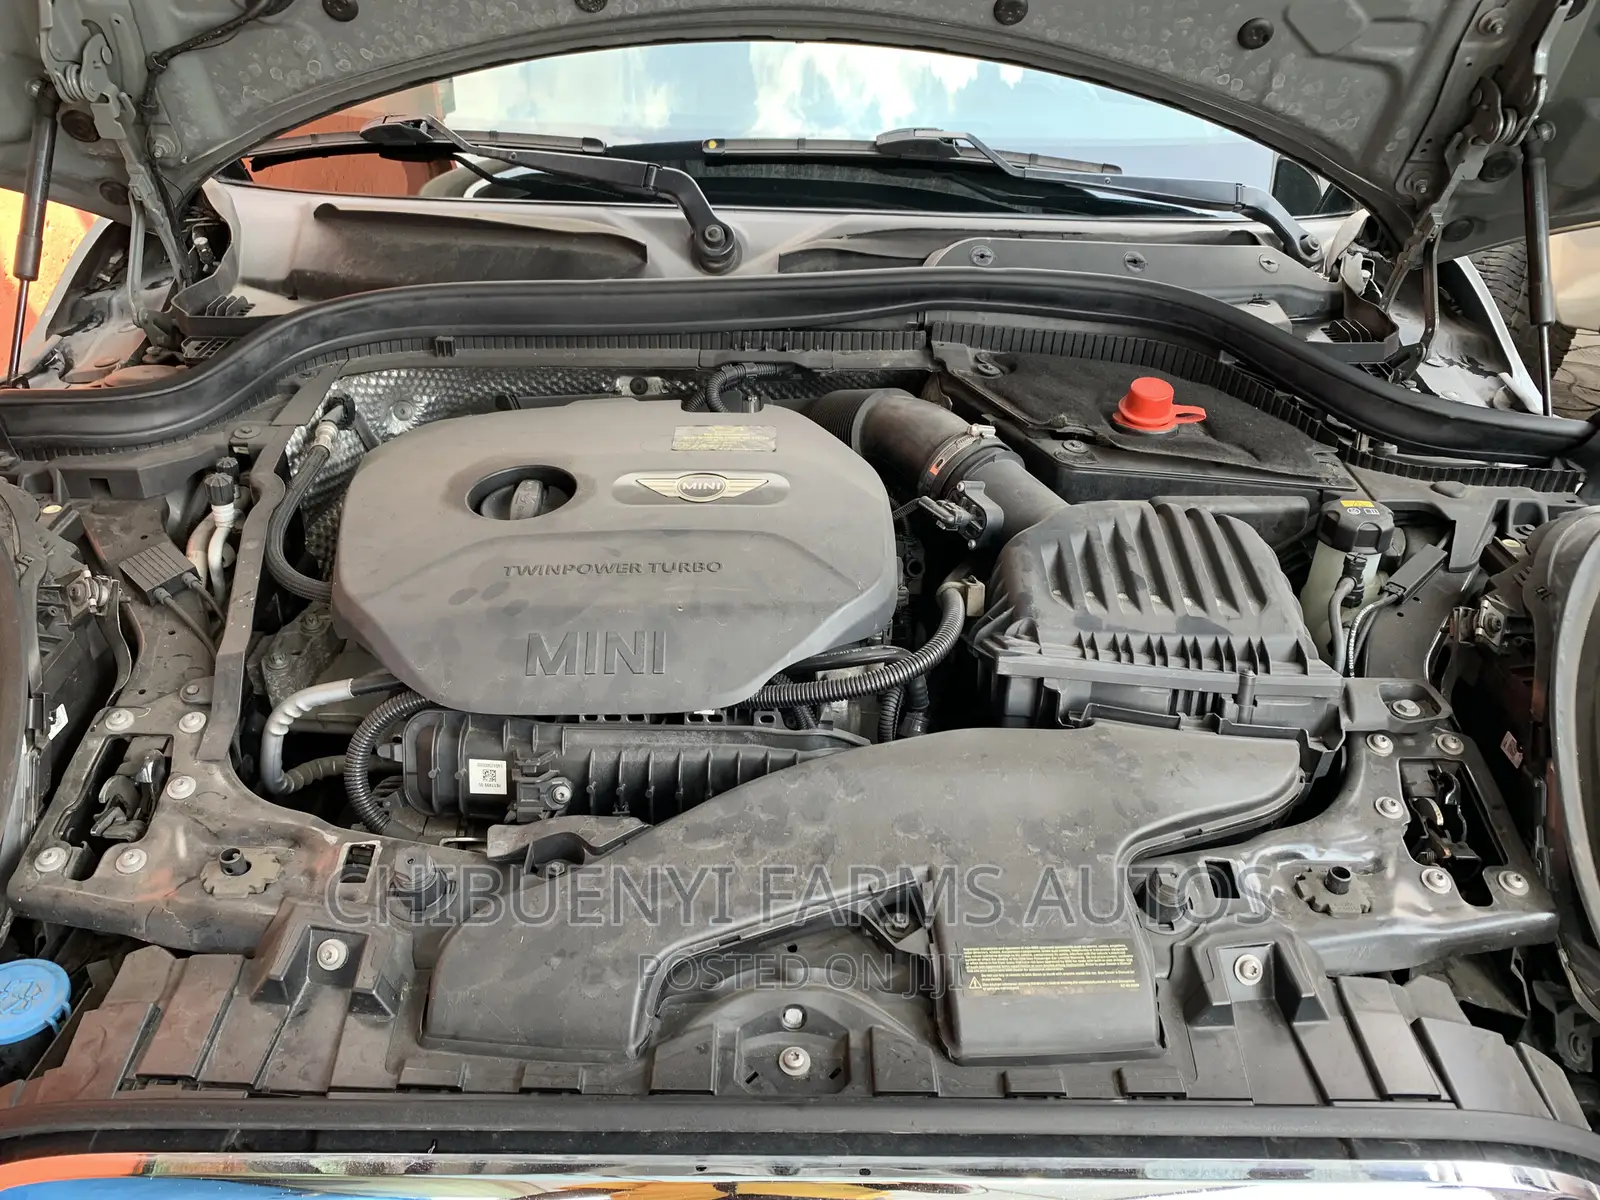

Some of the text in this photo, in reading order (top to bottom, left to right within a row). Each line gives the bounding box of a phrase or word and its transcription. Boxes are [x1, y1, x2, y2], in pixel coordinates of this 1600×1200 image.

[681, 480, 722, 492] MINI
[503, 561, 723, 577] TWINPOWER TURBO
[525, 631, 667, 677] MINI
